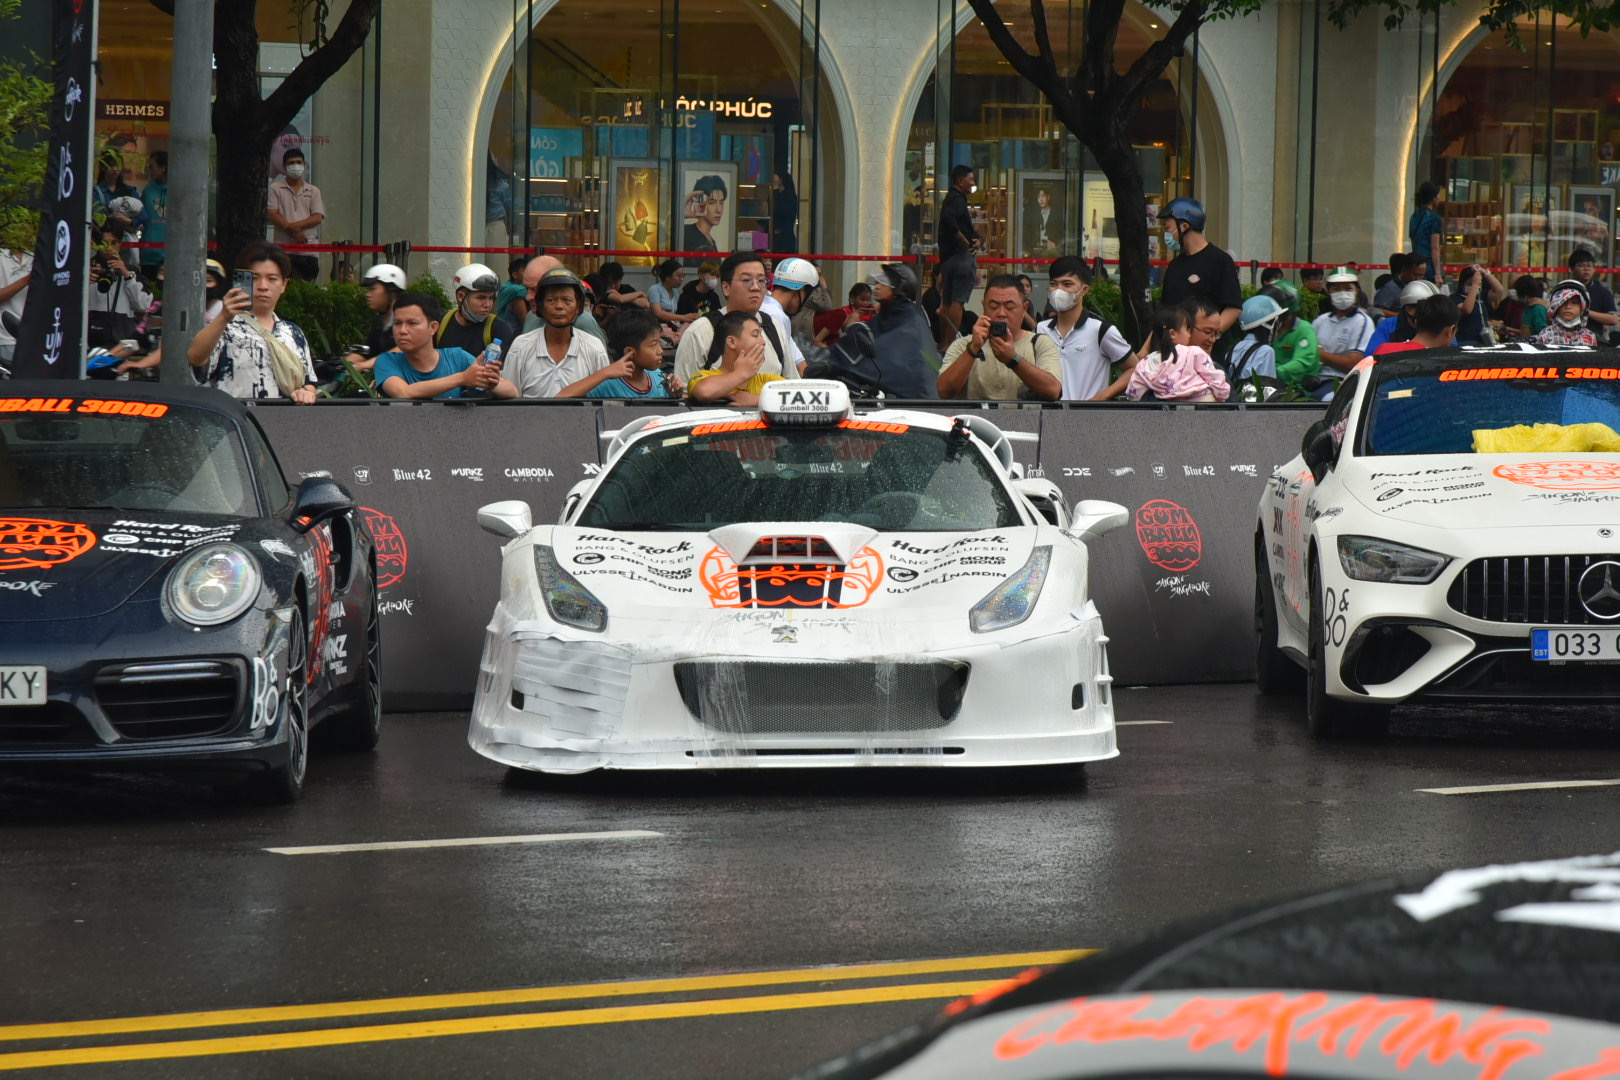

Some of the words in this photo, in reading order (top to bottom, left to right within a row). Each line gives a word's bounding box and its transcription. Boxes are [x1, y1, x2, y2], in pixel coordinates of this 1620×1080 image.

[710, 97, 772, 118] PHÚC
[1438, 367, 1560, 382] GUMBALL
[1565, 367, 1620, 380] 300
[778, 391, 830, 405] TAXI
[0, 399, 73, 412] BALL
[77, 400, 169, 418] 3000
[504, 468, 554, 477] CAMBODIA
[638, 541, 692, 554] Rock
[891, 539, 950, 555] Hard
[1555, 632, 1600, 656] 033
[0, 671, 38, 699] KY
